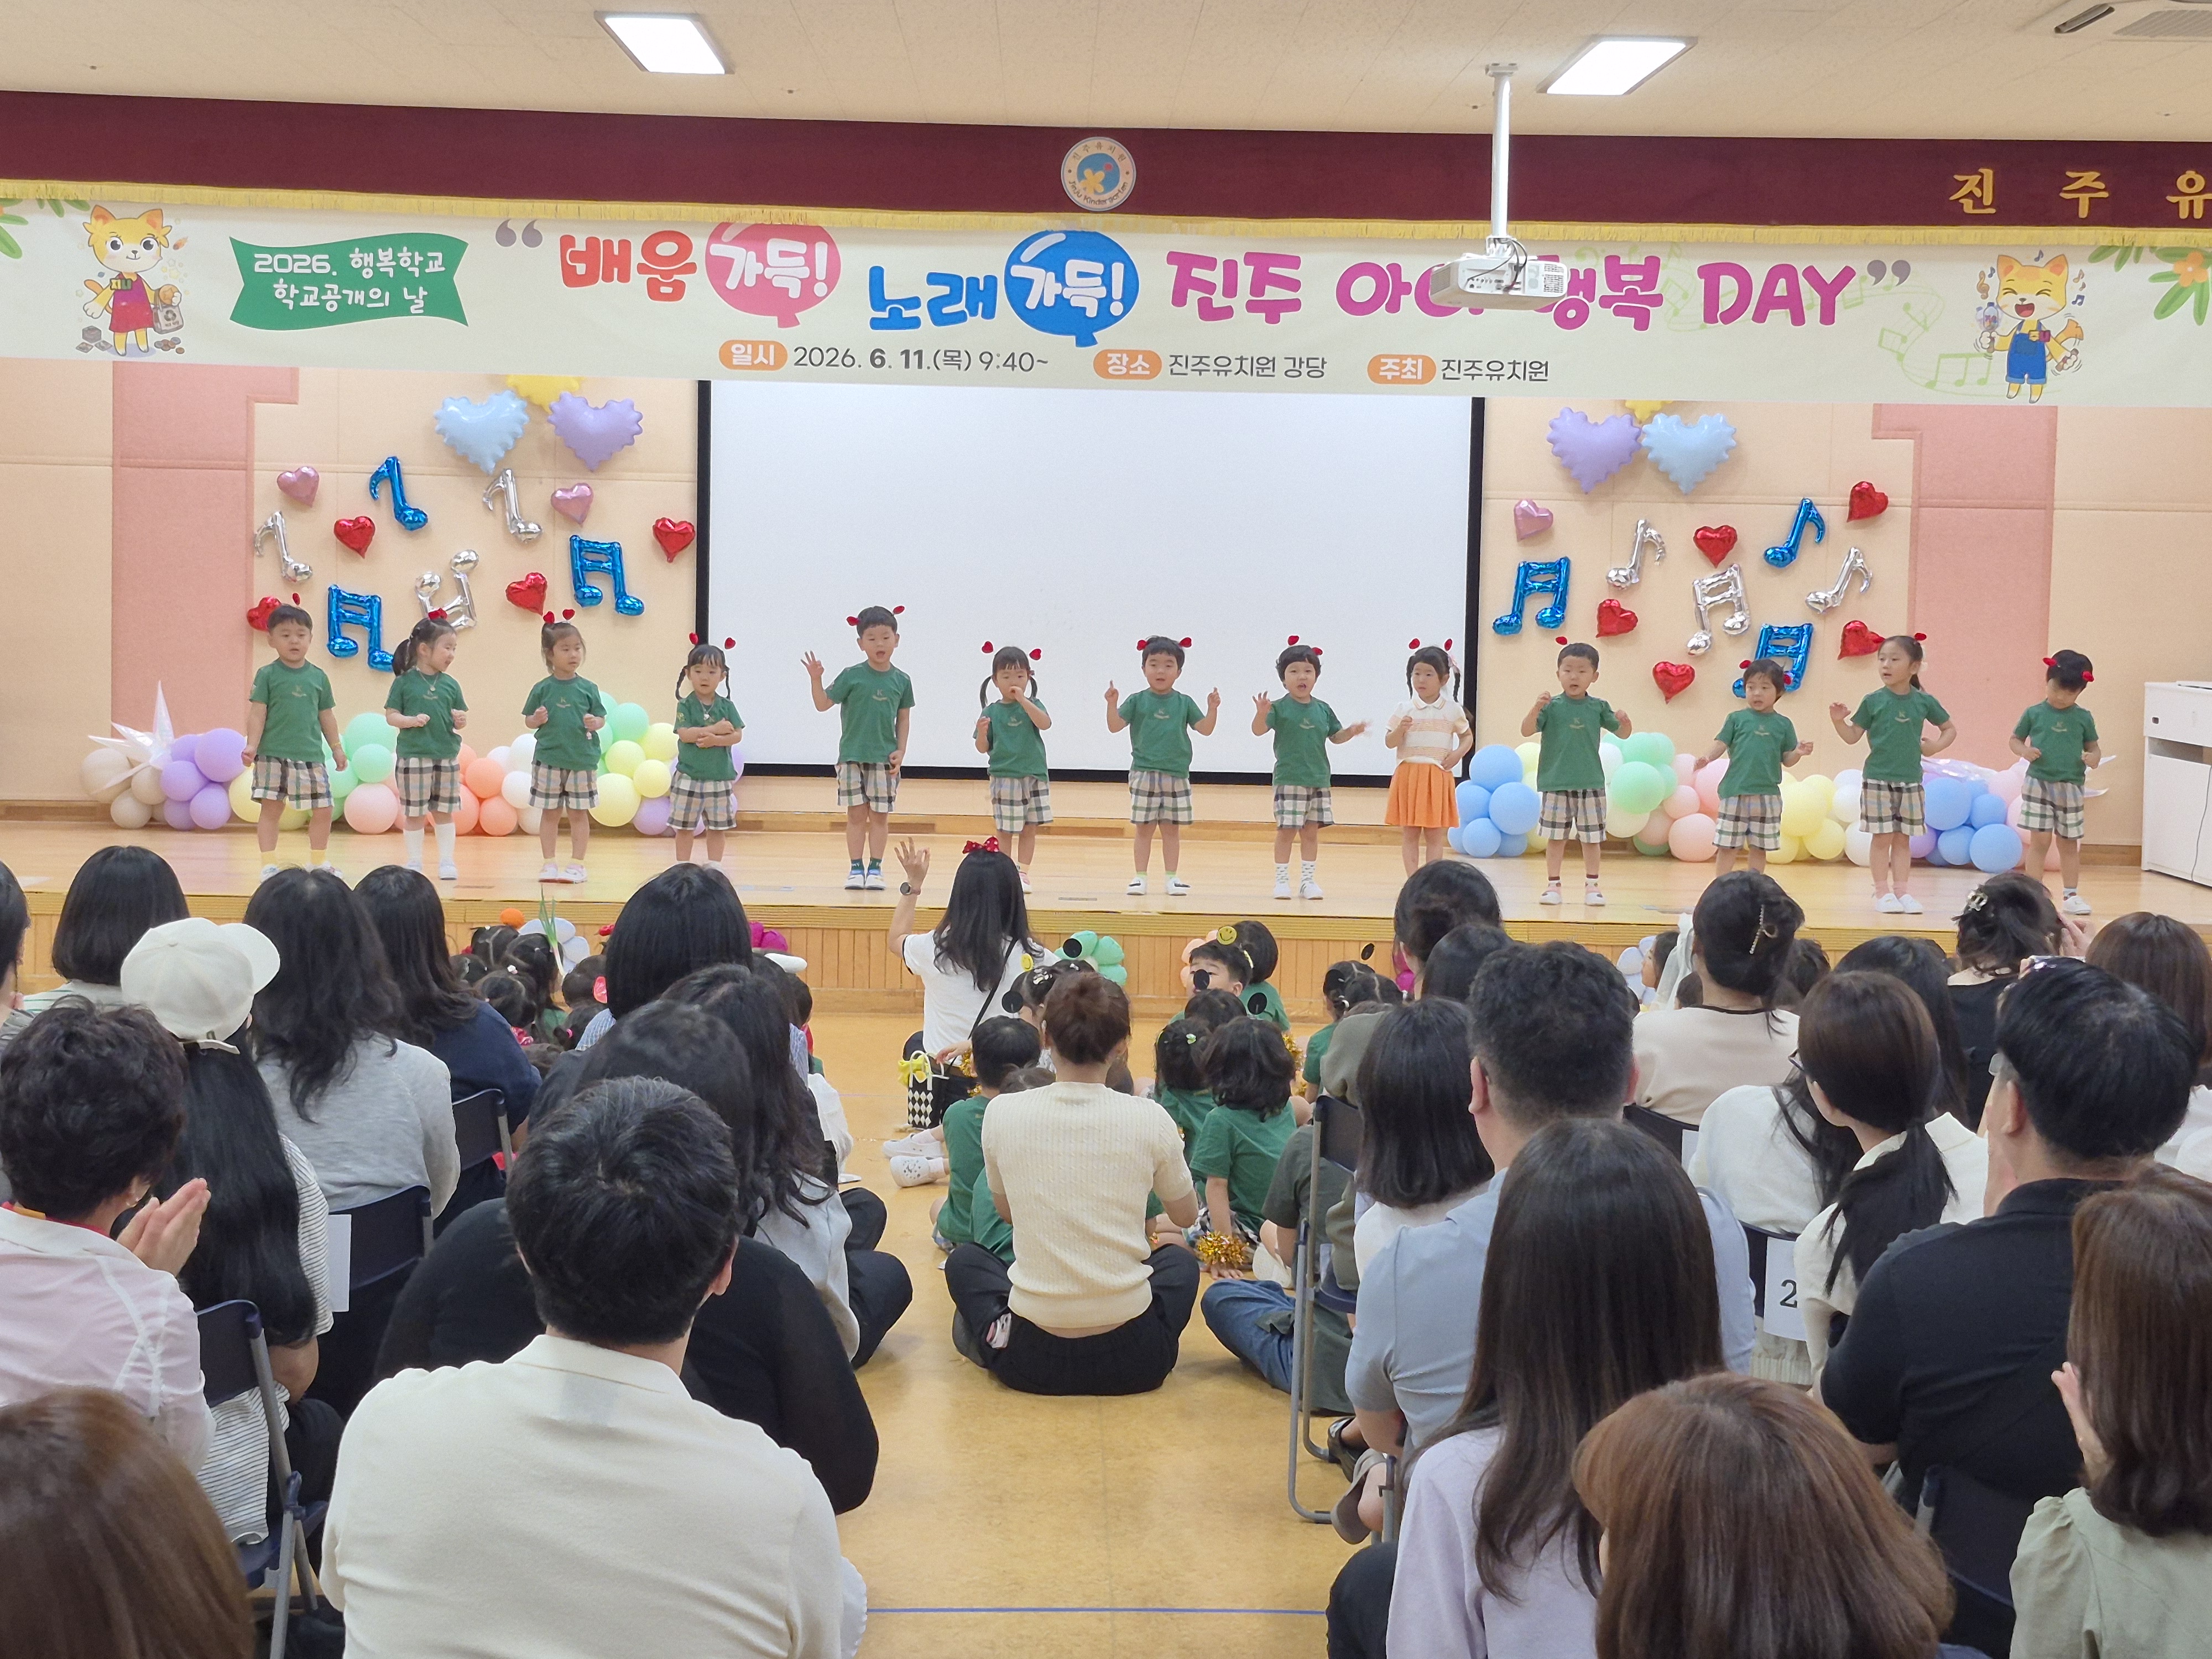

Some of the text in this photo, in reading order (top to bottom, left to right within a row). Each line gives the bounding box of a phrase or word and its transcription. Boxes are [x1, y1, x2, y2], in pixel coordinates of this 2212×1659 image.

[254, 246, 446, 279] 2026. 행복학교
[273, 278, 428, 314] 학교공개의 날
[709, 237, 828, 299] 가득!
[868, 265, 998, 331] 노래
[1010, 258, 1126, 318] 가득!
[1166, 251, 1302, 325] 진주
[731, 343, 1049, 372] 일시 2026. 6. 11.(목) 9:40~
[1107, 353, 1328, 379] 장소 진주유치원 강당
[1379, 357, 1549, 382] 주최 진주유치원
